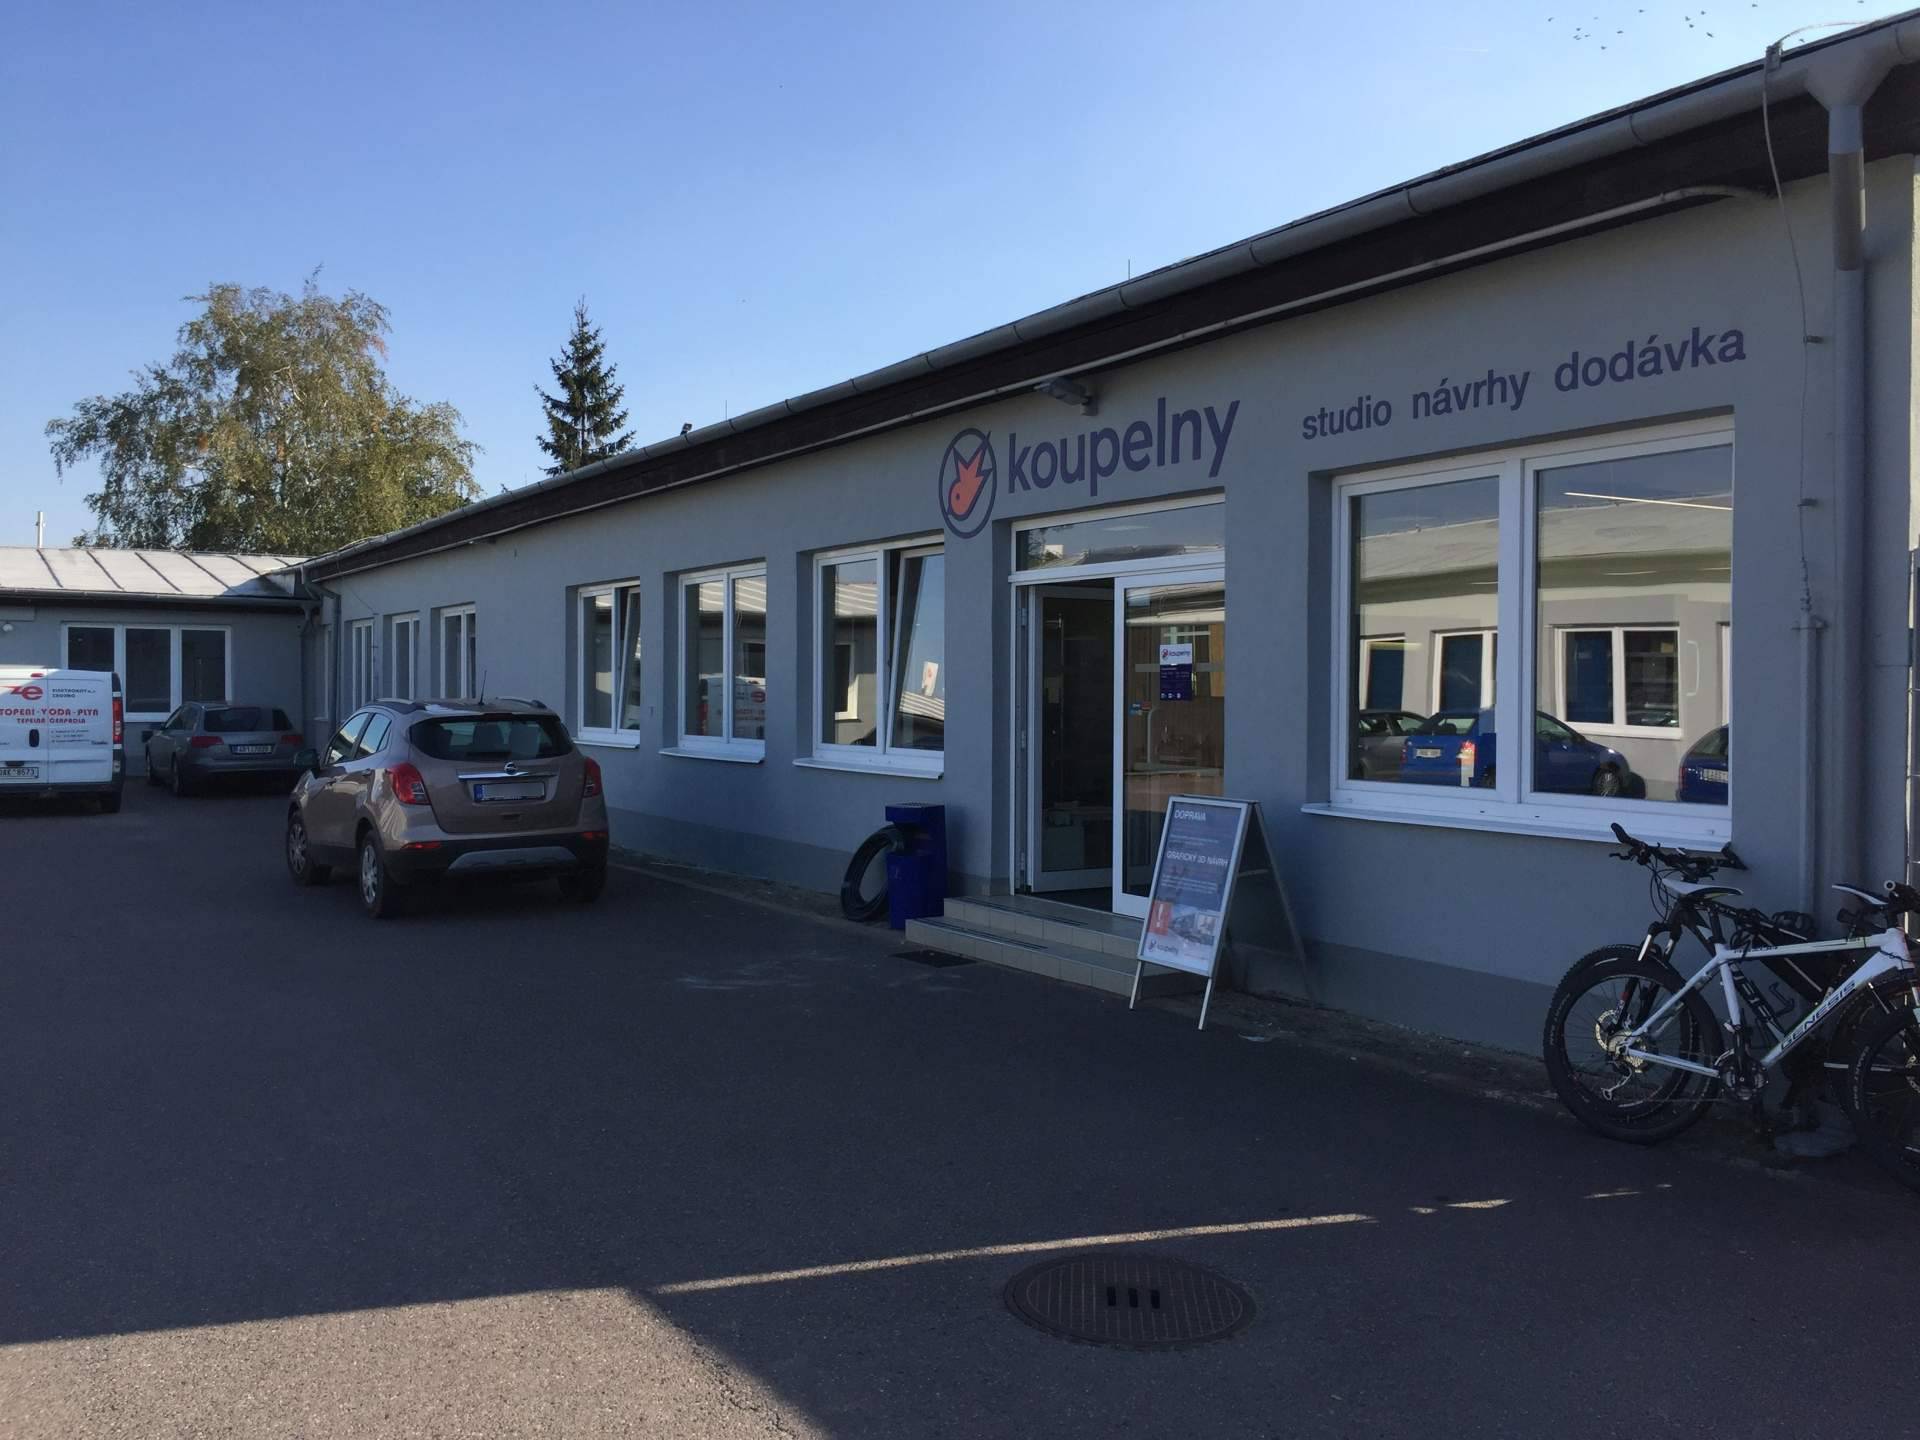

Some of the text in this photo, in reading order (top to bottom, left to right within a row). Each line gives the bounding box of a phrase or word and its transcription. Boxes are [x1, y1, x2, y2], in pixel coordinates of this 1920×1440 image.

[1302, 326, 1746, 440] studio návrhy dodávka
[1007, 396, 1241, 497] koupelny
[1174, 809, 1207, 821] DOPRAVA
[1781, 979, 1856, 1050] GENESIS
